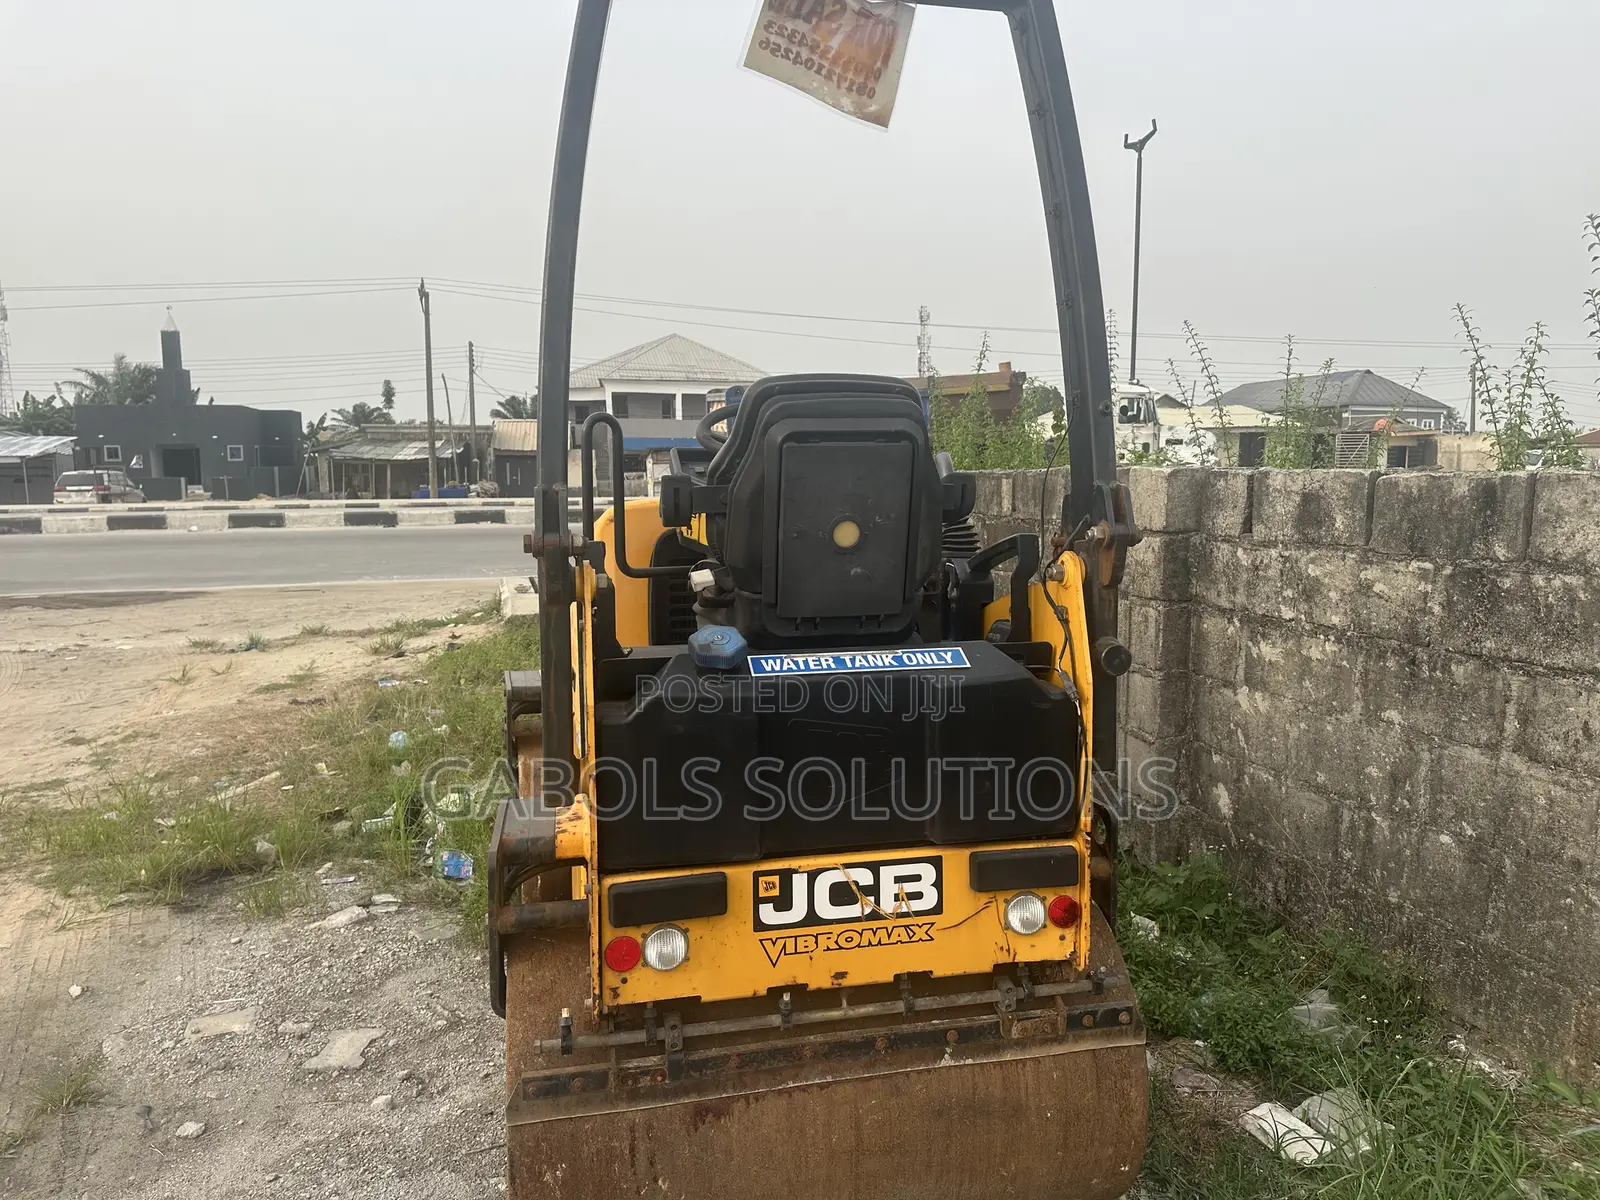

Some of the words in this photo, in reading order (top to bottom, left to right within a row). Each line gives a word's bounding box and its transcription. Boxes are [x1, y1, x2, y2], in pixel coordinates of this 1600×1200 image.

[760, 656, 837, 672] WATER
[840, 653, 899, 669] TANK
[902, 651, 954, 666] ONLY
[758, 862, 939, 926] JCB
[758, 922, 937, 968] VIBROMAX
